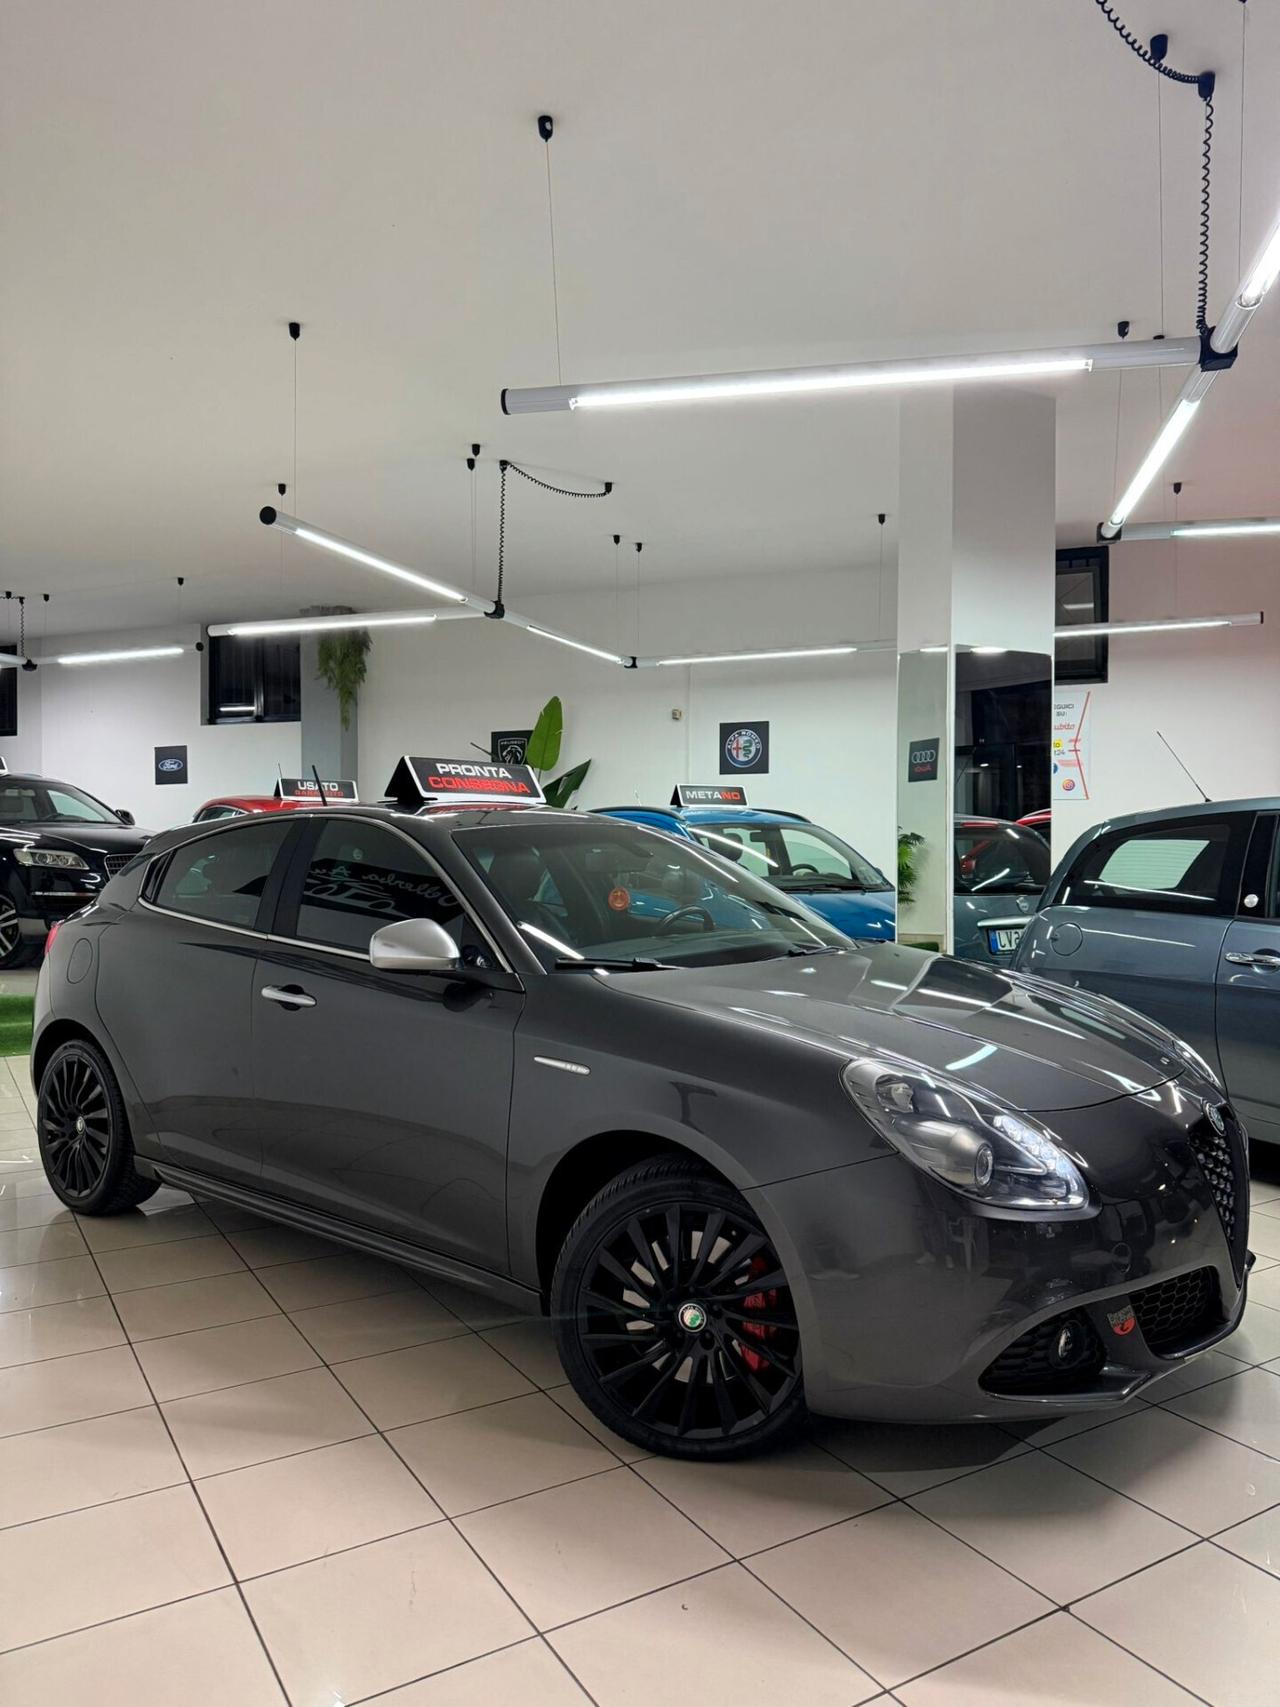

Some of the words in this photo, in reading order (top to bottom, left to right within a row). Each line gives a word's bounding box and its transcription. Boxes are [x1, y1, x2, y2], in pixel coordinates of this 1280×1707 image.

[435, 763, 513, 779] PRONTA
[427, 776, 531, 793] CONSEGNA
[685, 791, 741, 800] METANO
